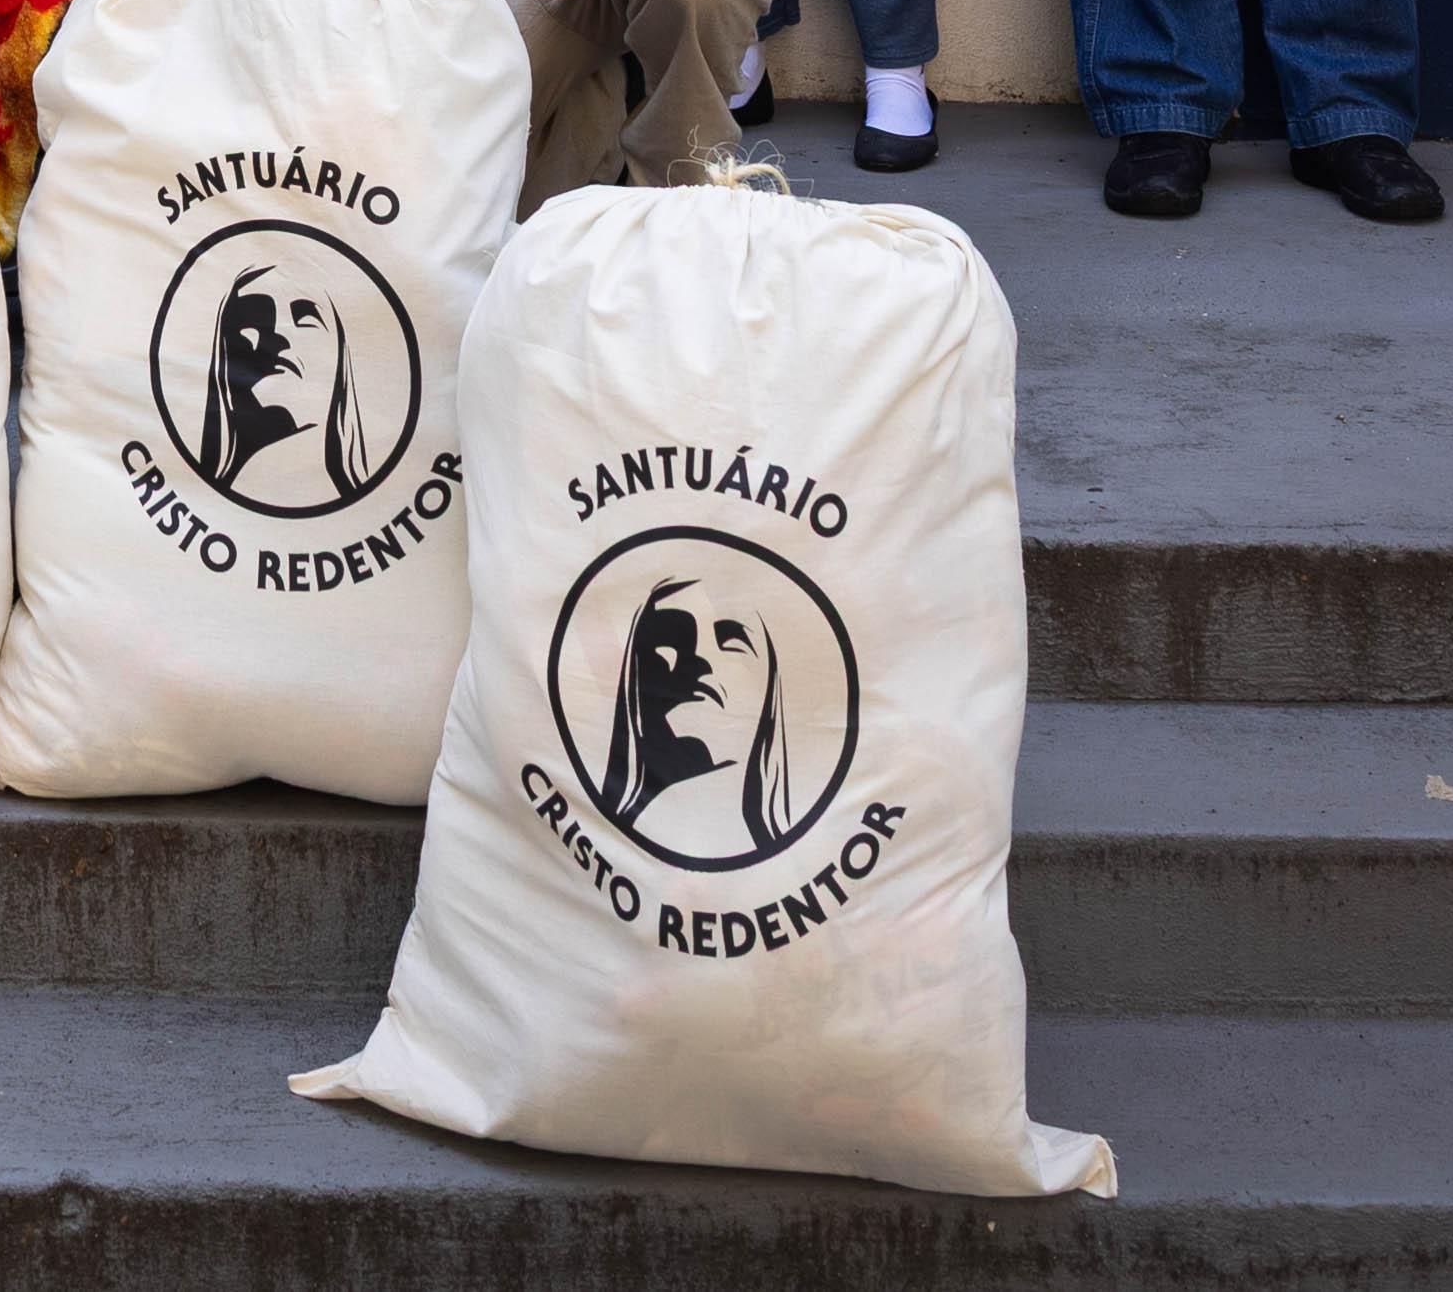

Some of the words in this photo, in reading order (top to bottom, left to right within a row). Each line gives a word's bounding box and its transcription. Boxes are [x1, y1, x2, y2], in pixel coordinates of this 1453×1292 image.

[156, 145, 401, 227] SANTUÁRIO
[120, 439, 238, 573] CRISTO
[256, 451, 464, 593] REDENTOR
[567, 446, 849, 539] SANTUÁRIO
[520, 762, 641, 923] CRISTO
[657, 801, 907, 960] REDENTOR
